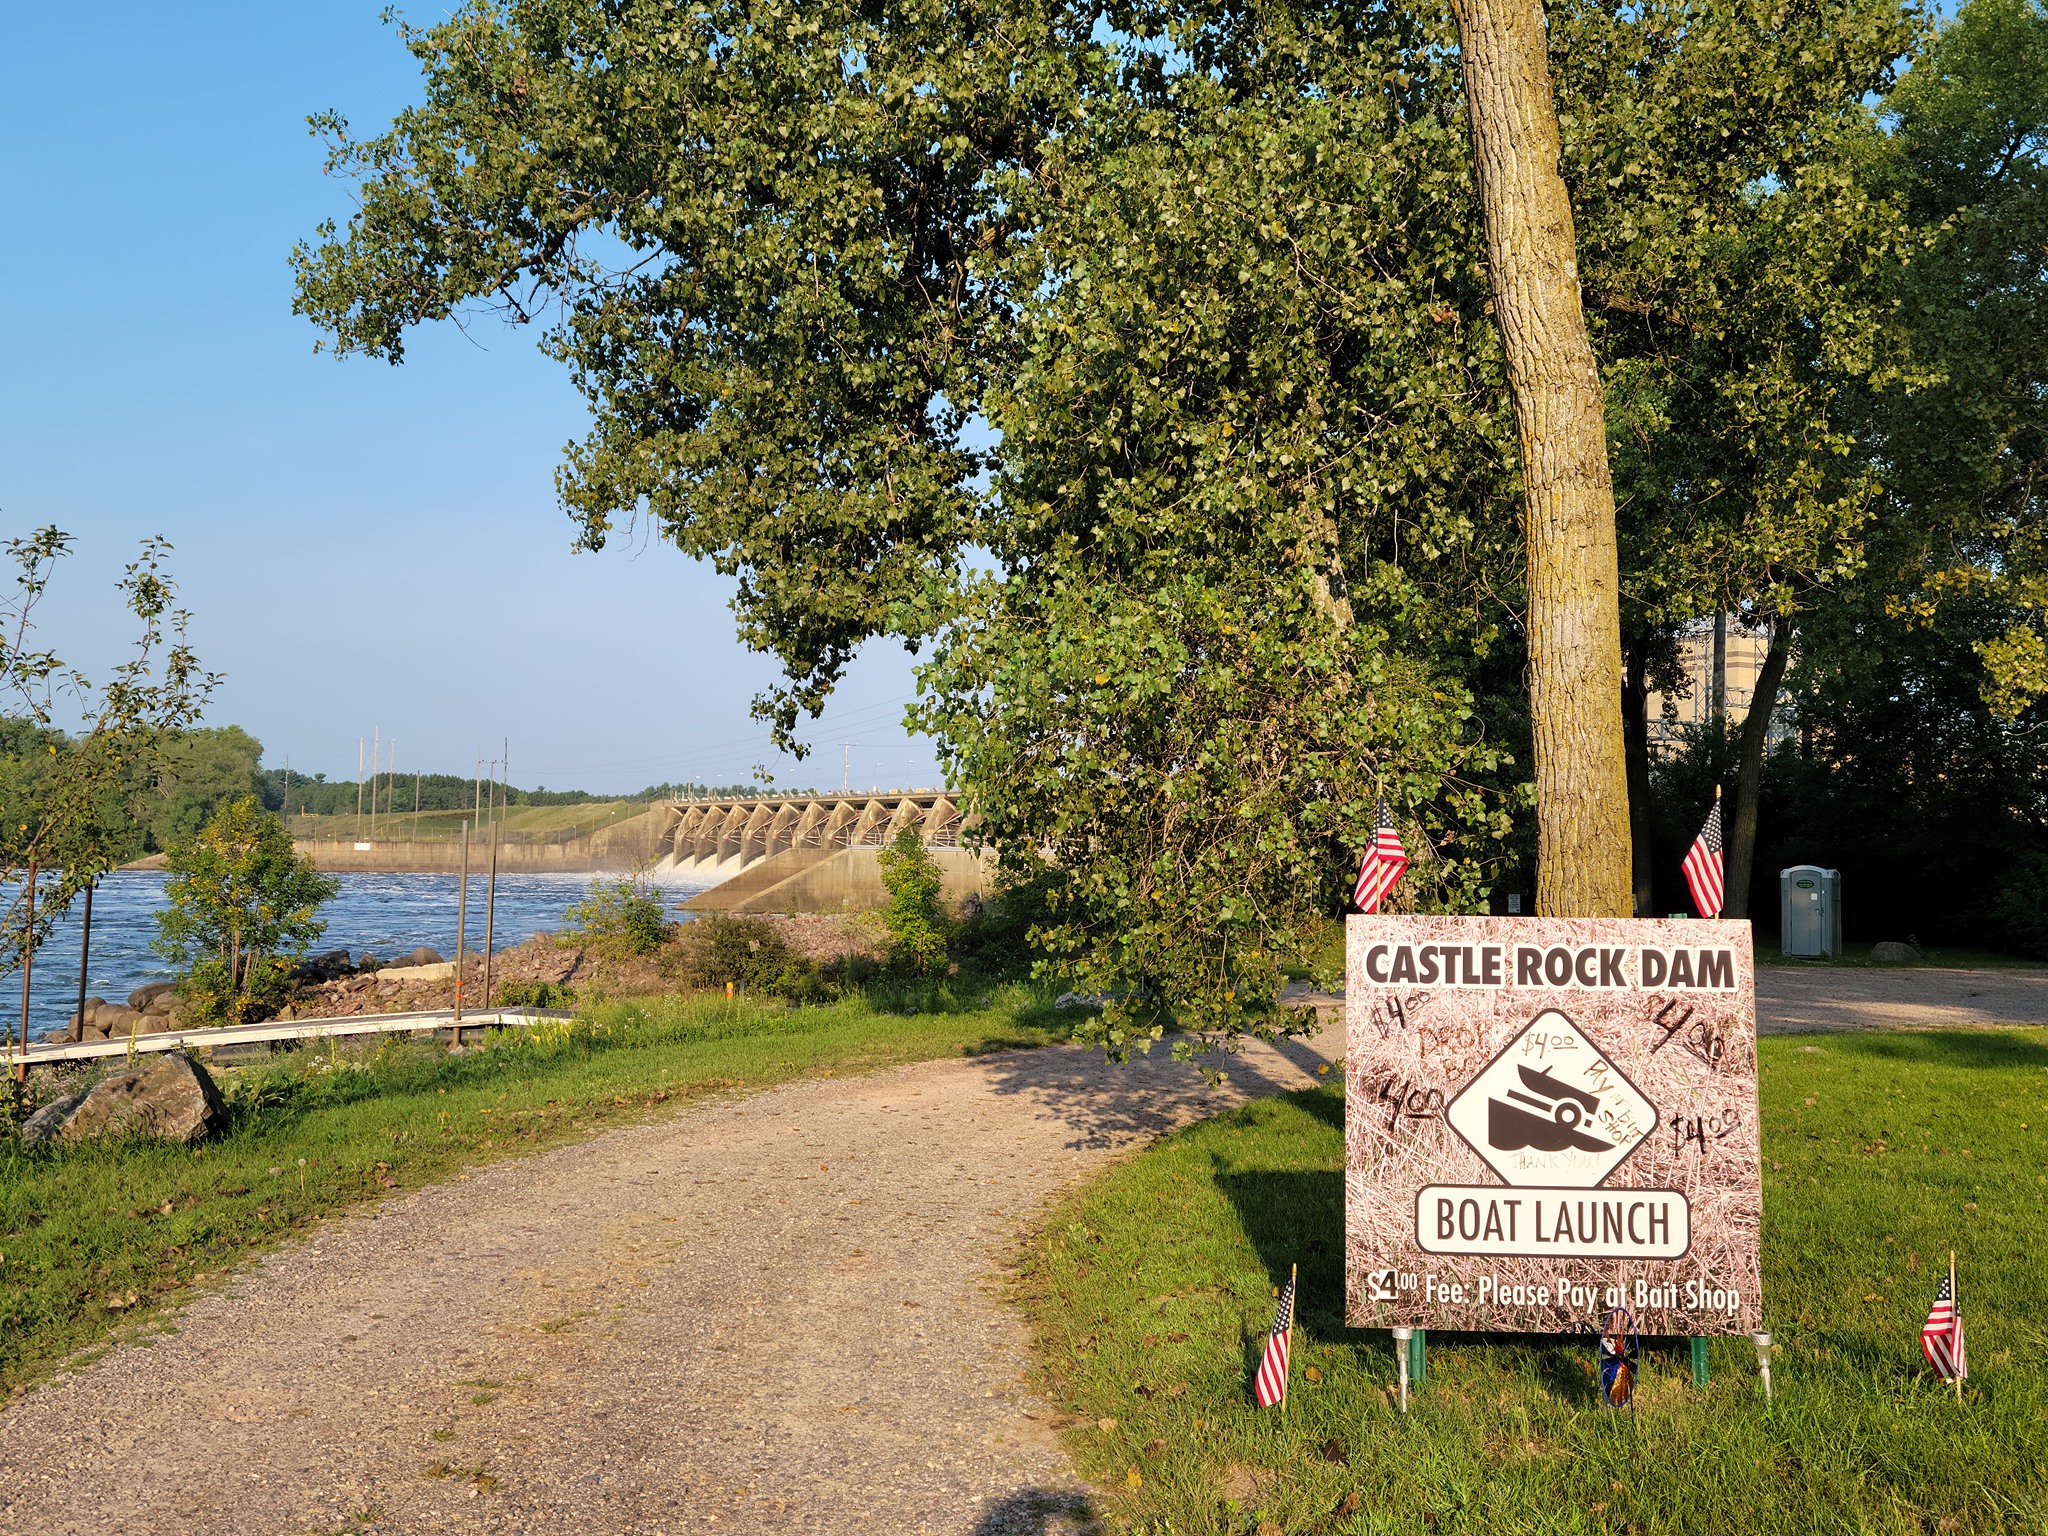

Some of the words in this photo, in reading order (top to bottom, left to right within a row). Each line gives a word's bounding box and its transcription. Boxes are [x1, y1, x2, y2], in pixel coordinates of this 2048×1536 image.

[1365, 945, 1502, 985] CASTLE
[1516, 947, 1628, 988] ROCK
[1640, 948, 1735, 989] DAM
[1437, 1197, 1522, 1241] BOAT
[1535, 1200, 1669, 1245] LAUNCH
[1425, 1273, 1470, 1304] Fee:
[1479, 1274, 1549, 1306] Please
[1558, 1277, 1598, 1314] Pay
[1605, 1284, 1628, 1308] at
[1635, 1279, 1679, 1309] Bait
[1685, 1278, 1741, 1317] Shop
